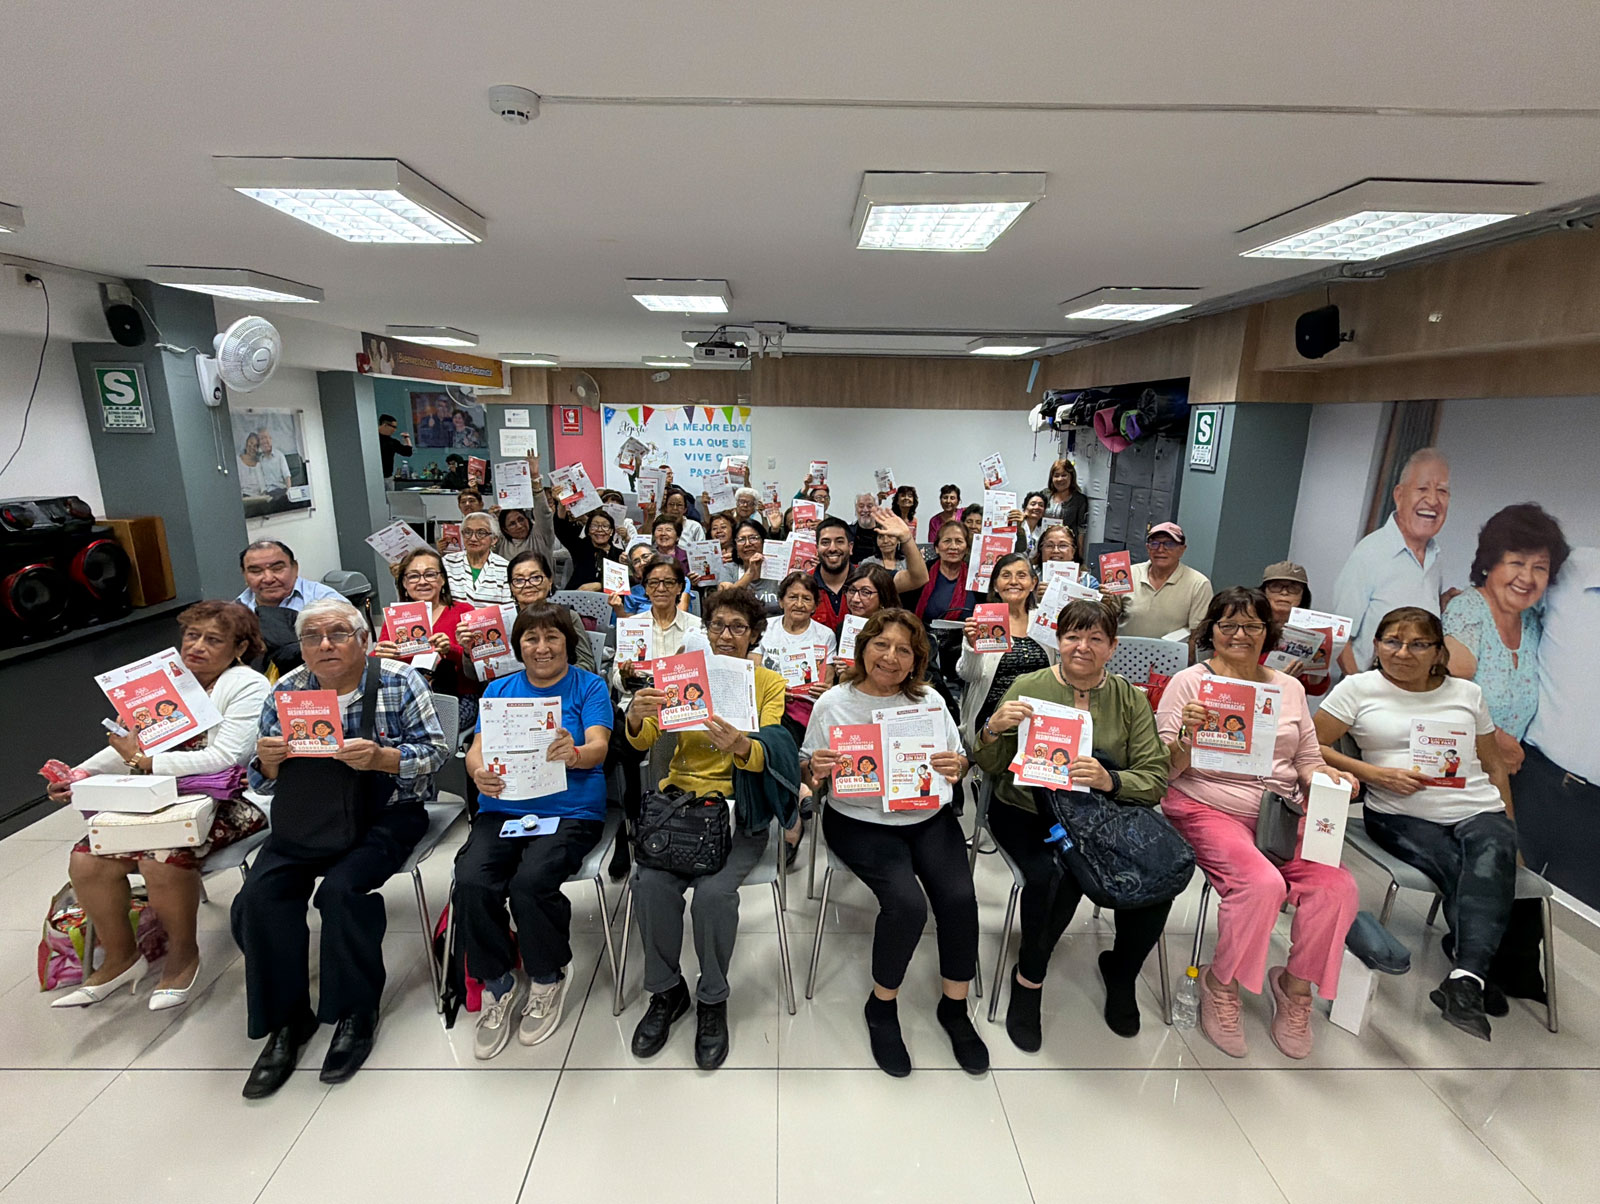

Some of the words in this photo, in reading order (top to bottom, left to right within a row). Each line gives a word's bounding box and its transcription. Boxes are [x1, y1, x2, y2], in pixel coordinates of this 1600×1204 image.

[104, 371, 135, 404] S
[683, 423, 720, 432] MEJOR
[723, 424, 752, 432] EDAD
[1198, 415, 1212, 442] S
[707, 439, 729, 448] QUE
[732, 440, 746, 448] SE
[684, 453, 712, 462] VIVE
[662, 708, 678, 716] ¡QUE
[158, 720, 169, 728] NO
